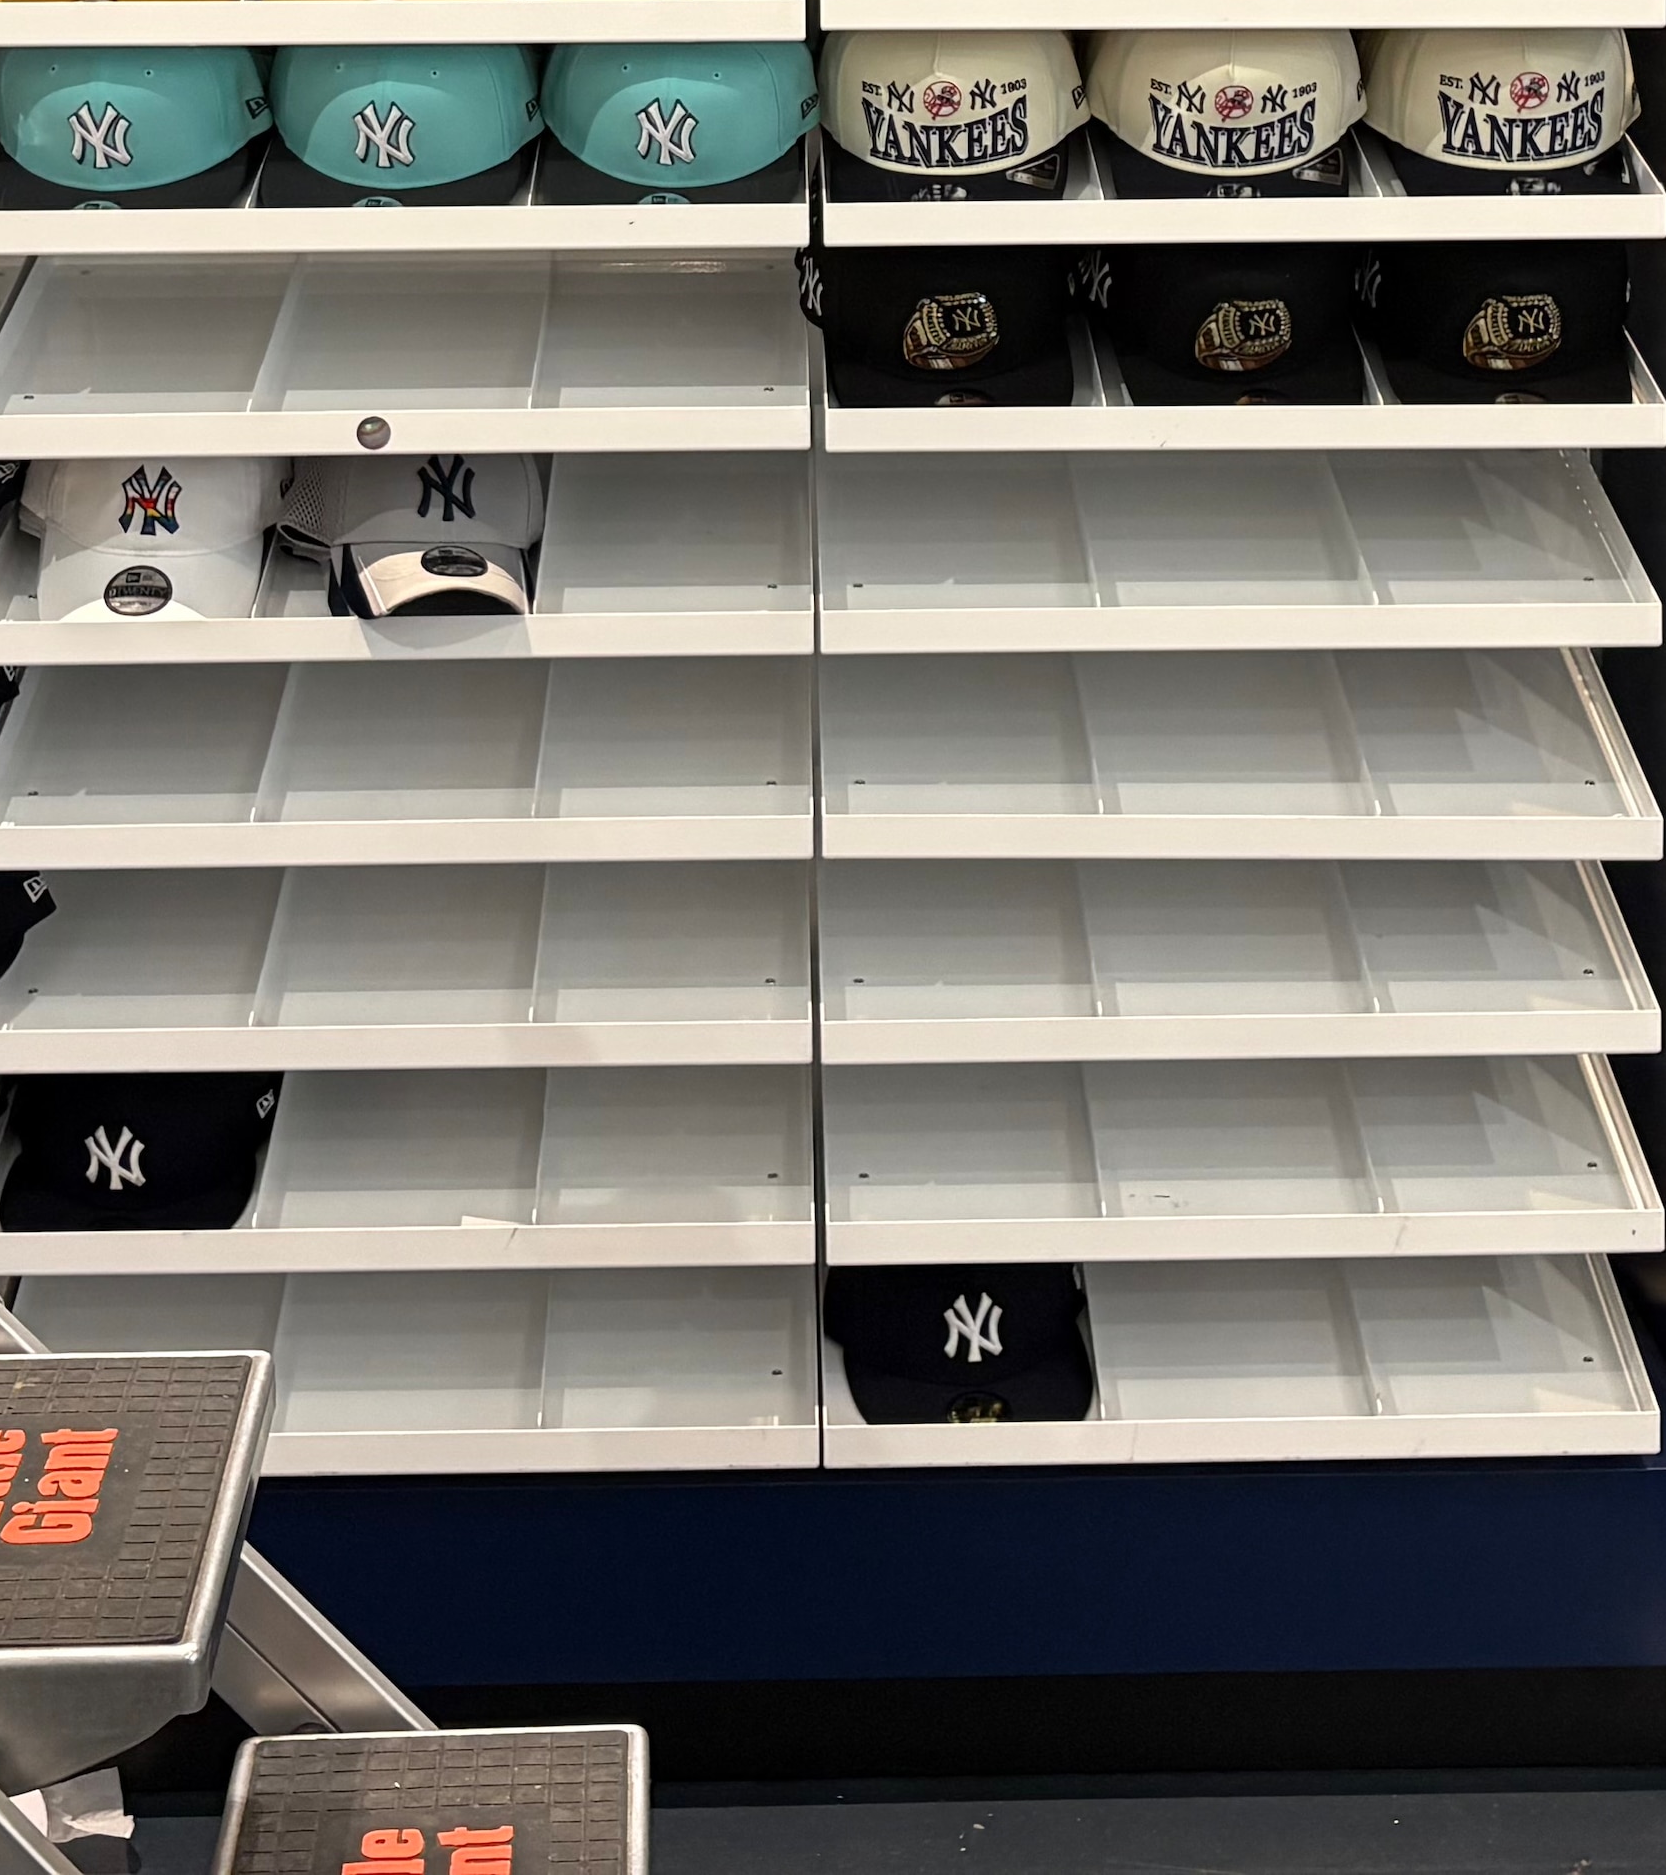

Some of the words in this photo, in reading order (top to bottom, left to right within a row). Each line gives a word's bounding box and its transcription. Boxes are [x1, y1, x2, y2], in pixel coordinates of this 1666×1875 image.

[887, 81, 915, 113] NY
[969, 78, 998, 110] NY
[1468, 71, 1501, 105] NY
[1557, 71, 1580, 102] NY
[66, 100, 134, 170] NY
[352, 100, 415, 169] NY
[861, 94, 1029, 168] YANKEES
[1438, 87, 1605, 163] YANKEES
[952, 307, 981, 331] NY
[1249, 312, 1275, 336] NY
[118, 464, 182, 536] NY
[416, 454, 477, 522] NY
[943, 1291, 1004, 1363] NY
